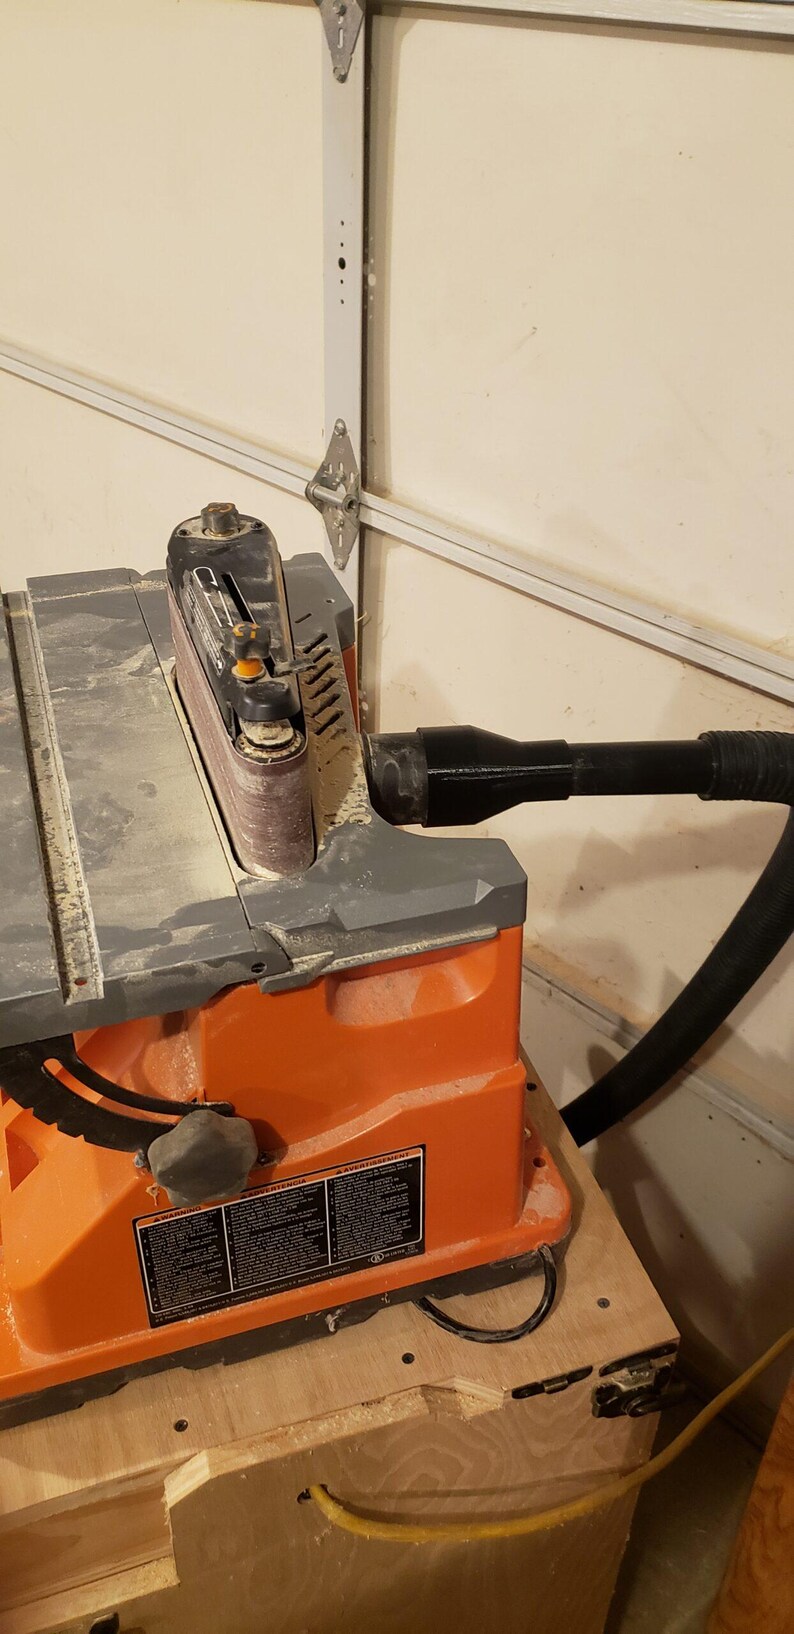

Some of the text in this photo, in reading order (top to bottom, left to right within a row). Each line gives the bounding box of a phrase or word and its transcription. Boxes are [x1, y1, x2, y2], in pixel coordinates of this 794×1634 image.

[342, 1151, 409, 1173] AVERTISSEMENT
[248, 1178, 306, 1198] ADVERTENCIA
[160, 1205, 202, 1221] WARNING
